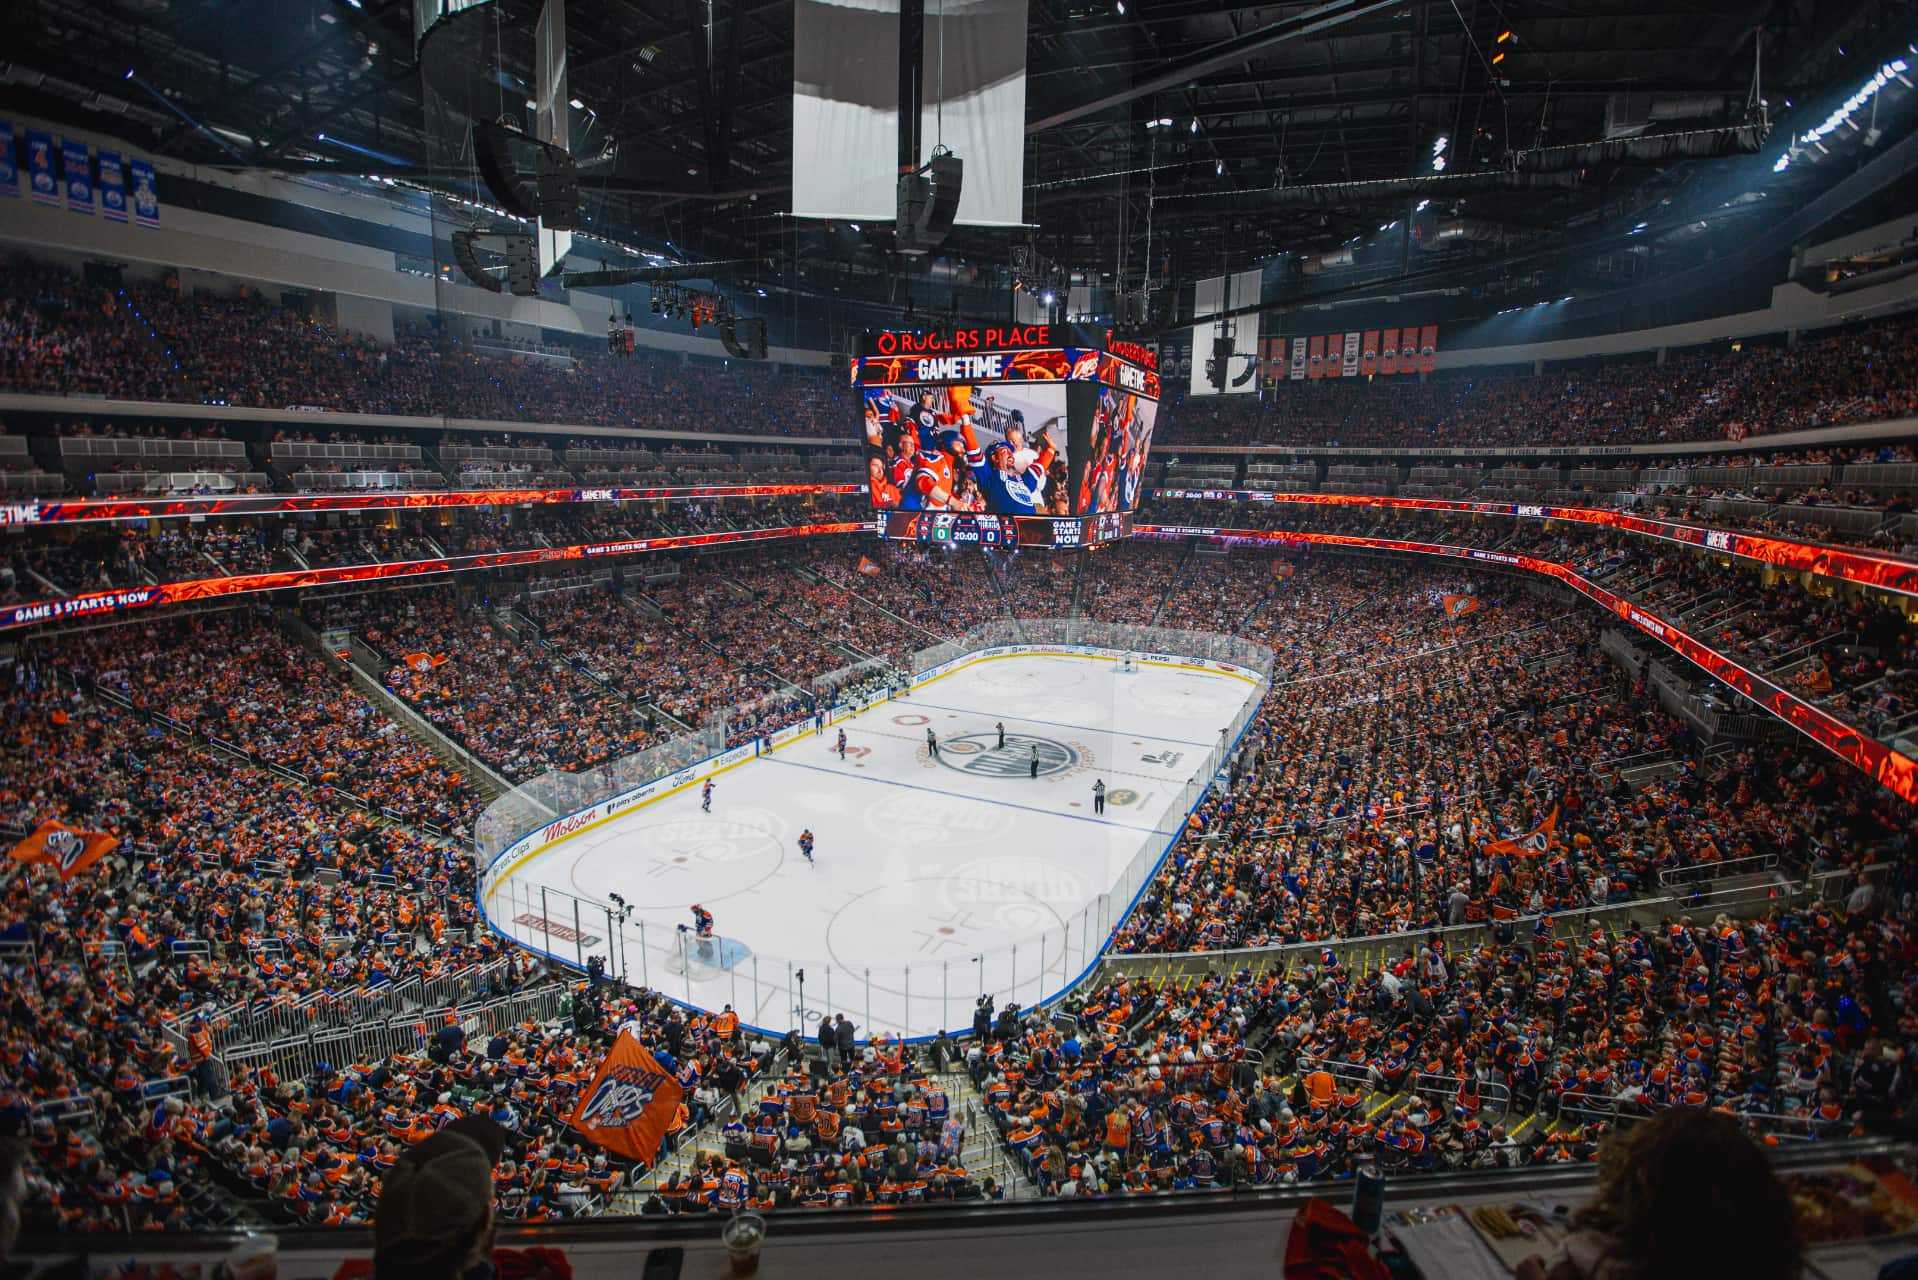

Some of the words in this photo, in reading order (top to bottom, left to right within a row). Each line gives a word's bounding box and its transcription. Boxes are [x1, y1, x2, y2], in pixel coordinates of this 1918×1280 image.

[986, 326, 1049, 346] PLACE
[918, 355, 1002, 380] GAMETIME
[1053, 521, 1076, 529] GAME
[937, 529, 945, 540] 0
[954, 532, 978, 541] 20:00
[987, 531, 994, 541] 0
[1055, 535, 1079, 544] NOW
[15, 605, 51, 622] GAME
[54, 603, 62, 615] 3
[65, 596, 114, 613] STARTS
[118, 591, 149, 604] NOW
[673, 769, 697, 787] Ford
[632, 787, 655, 801] alberta
[543, 810, 597, 843] Molson
[511, 842, 530, 858] Clips
